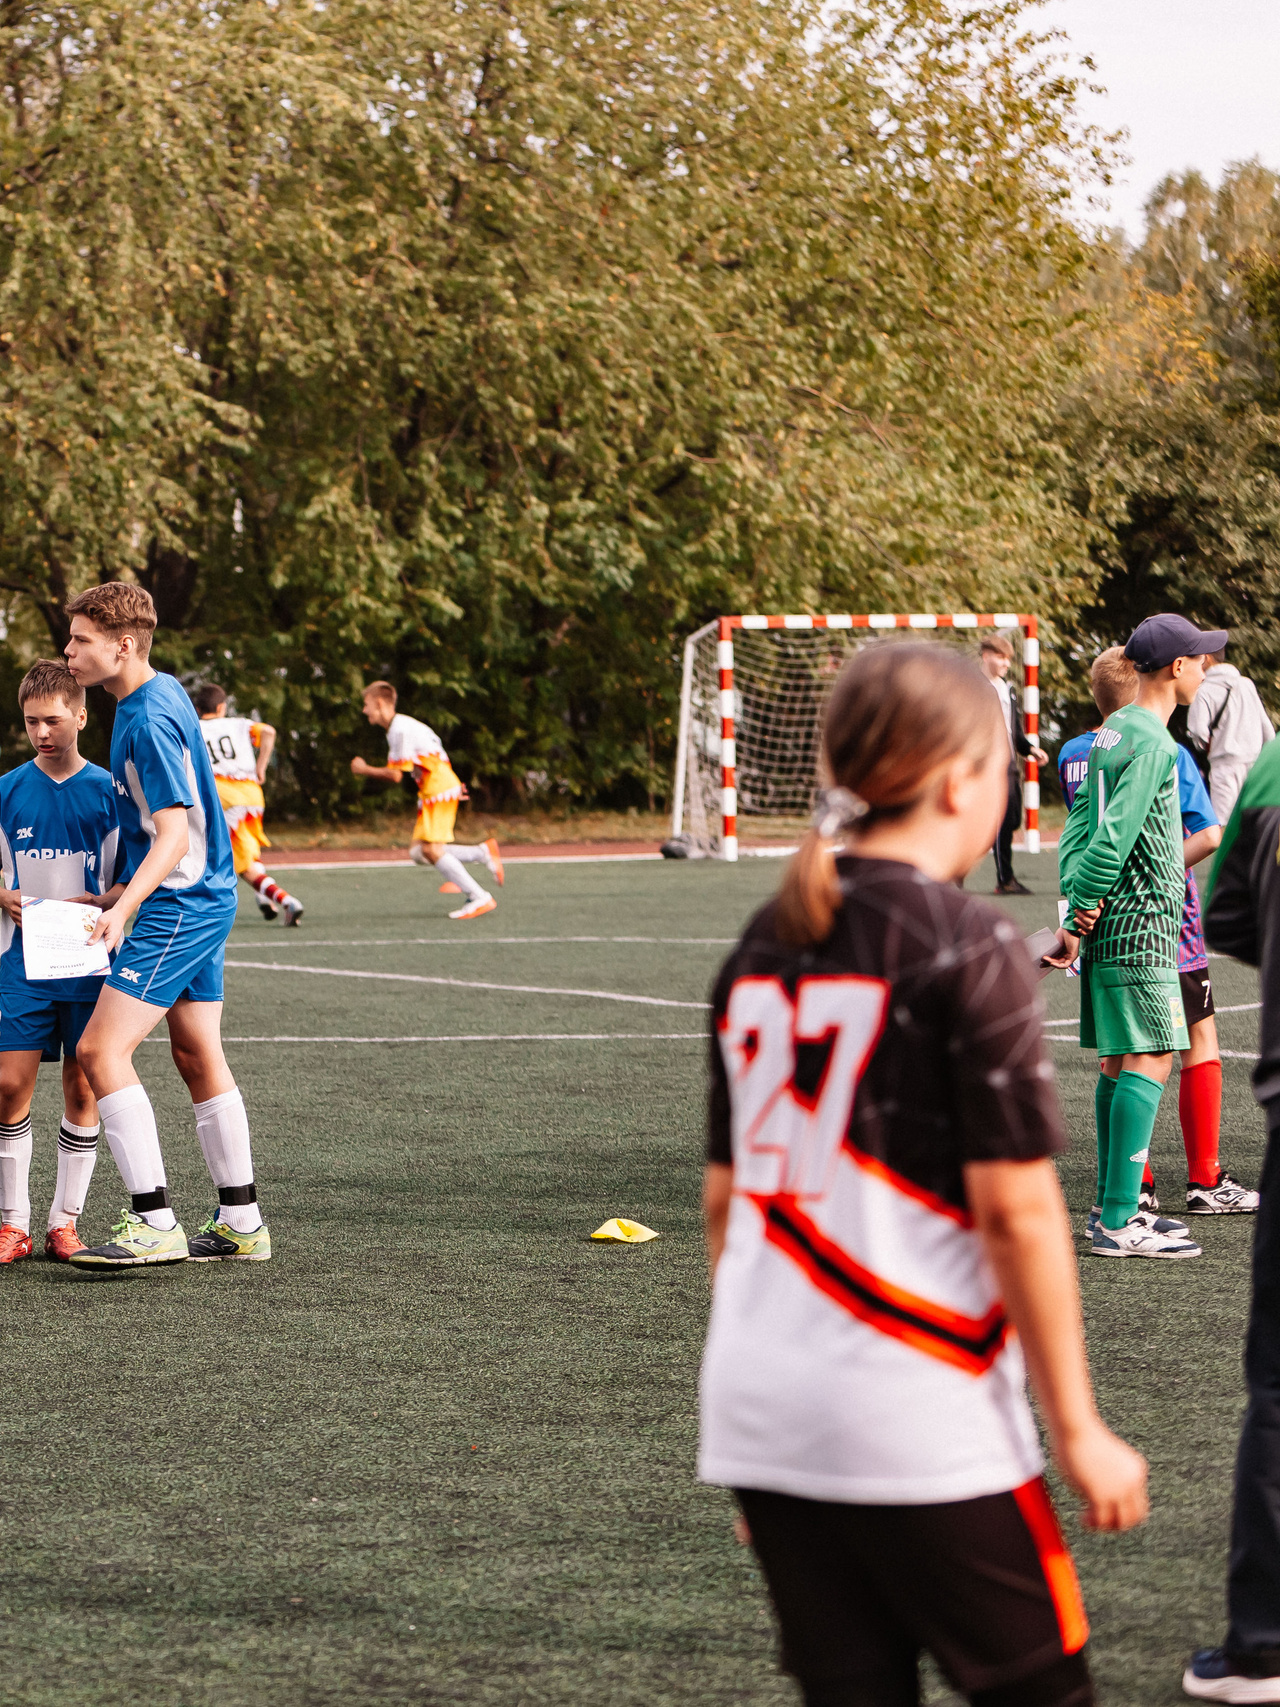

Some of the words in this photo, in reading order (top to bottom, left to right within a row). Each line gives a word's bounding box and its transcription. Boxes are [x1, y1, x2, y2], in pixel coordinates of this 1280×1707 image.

[207, 735, 236, 764] 10
[1201, 980, 1211, 1008] 7
[717, 974, 892, 1201] 27
